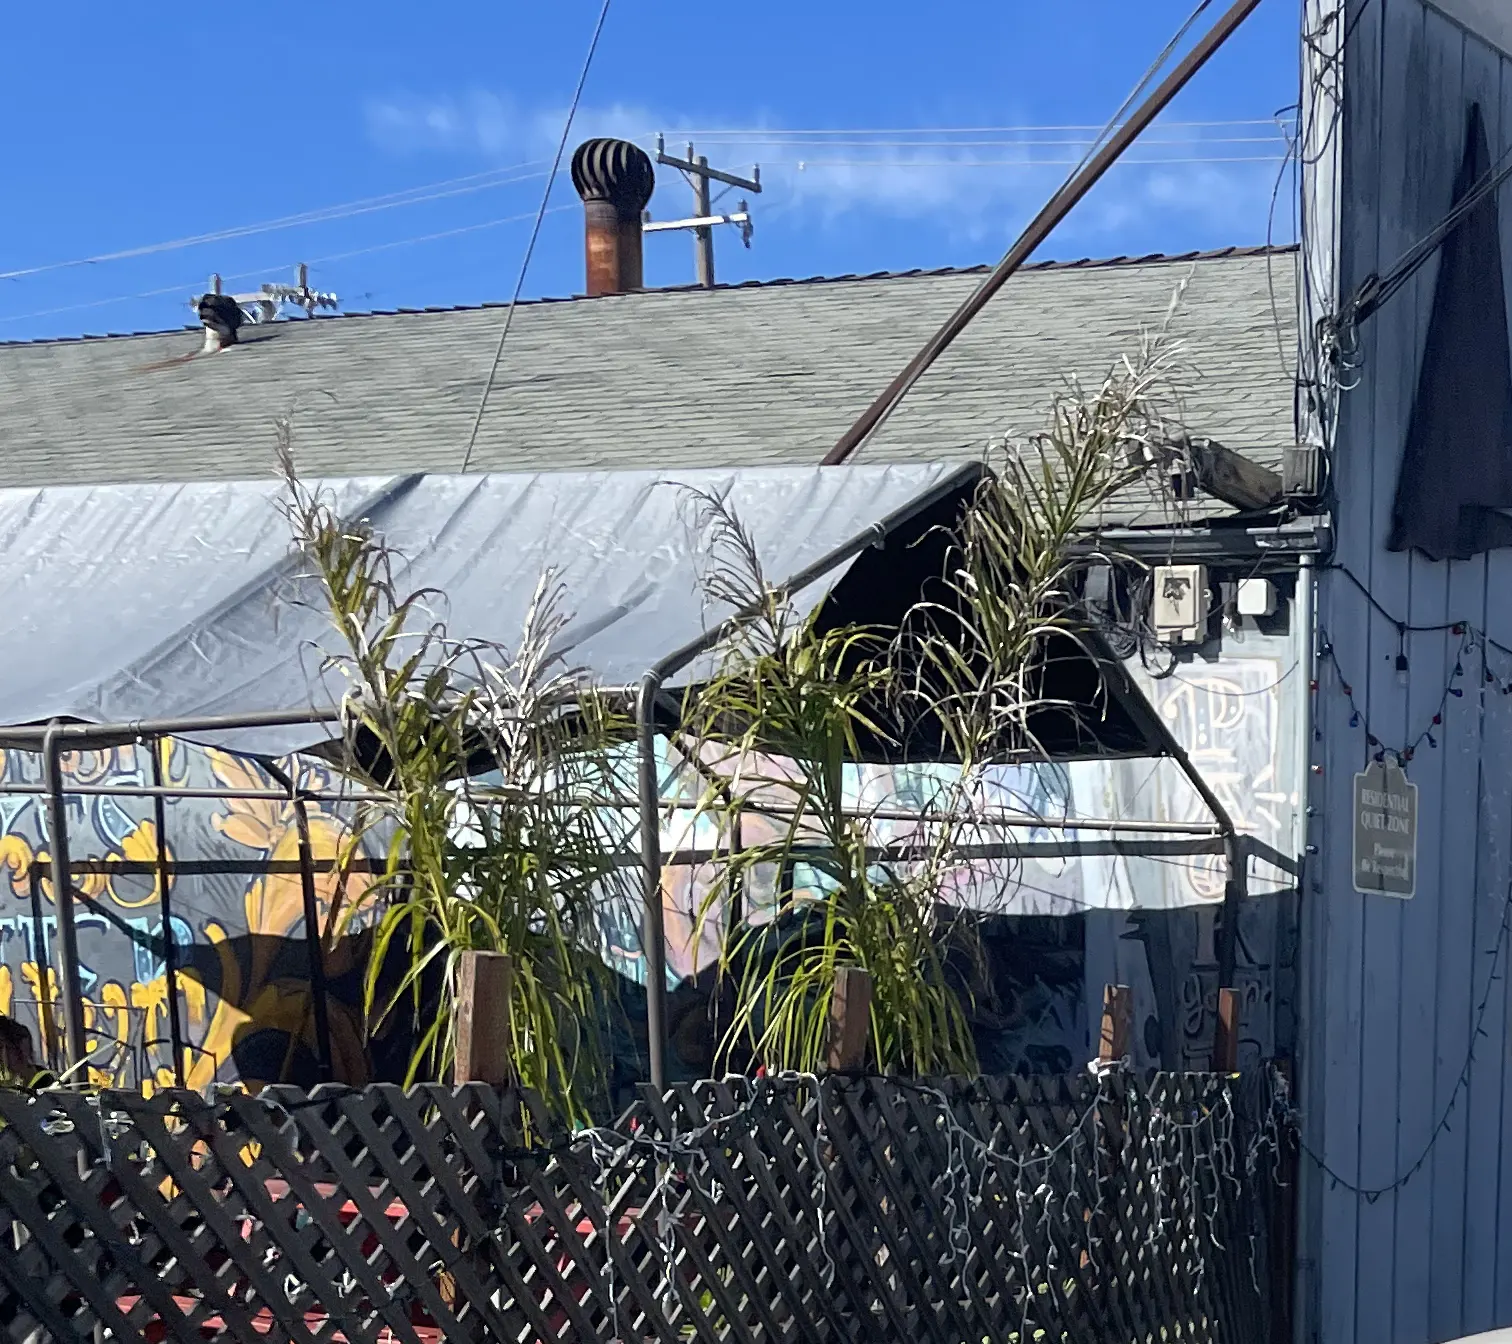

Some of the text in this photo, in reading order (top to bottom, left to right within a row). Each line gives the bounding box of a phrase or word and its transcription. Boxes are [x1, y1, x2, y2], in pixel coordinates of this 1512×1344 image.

[1361, 788, 1409, 813] RESIDENTIAL
[1361, 810, 1410, 834] QUIET ZONE
